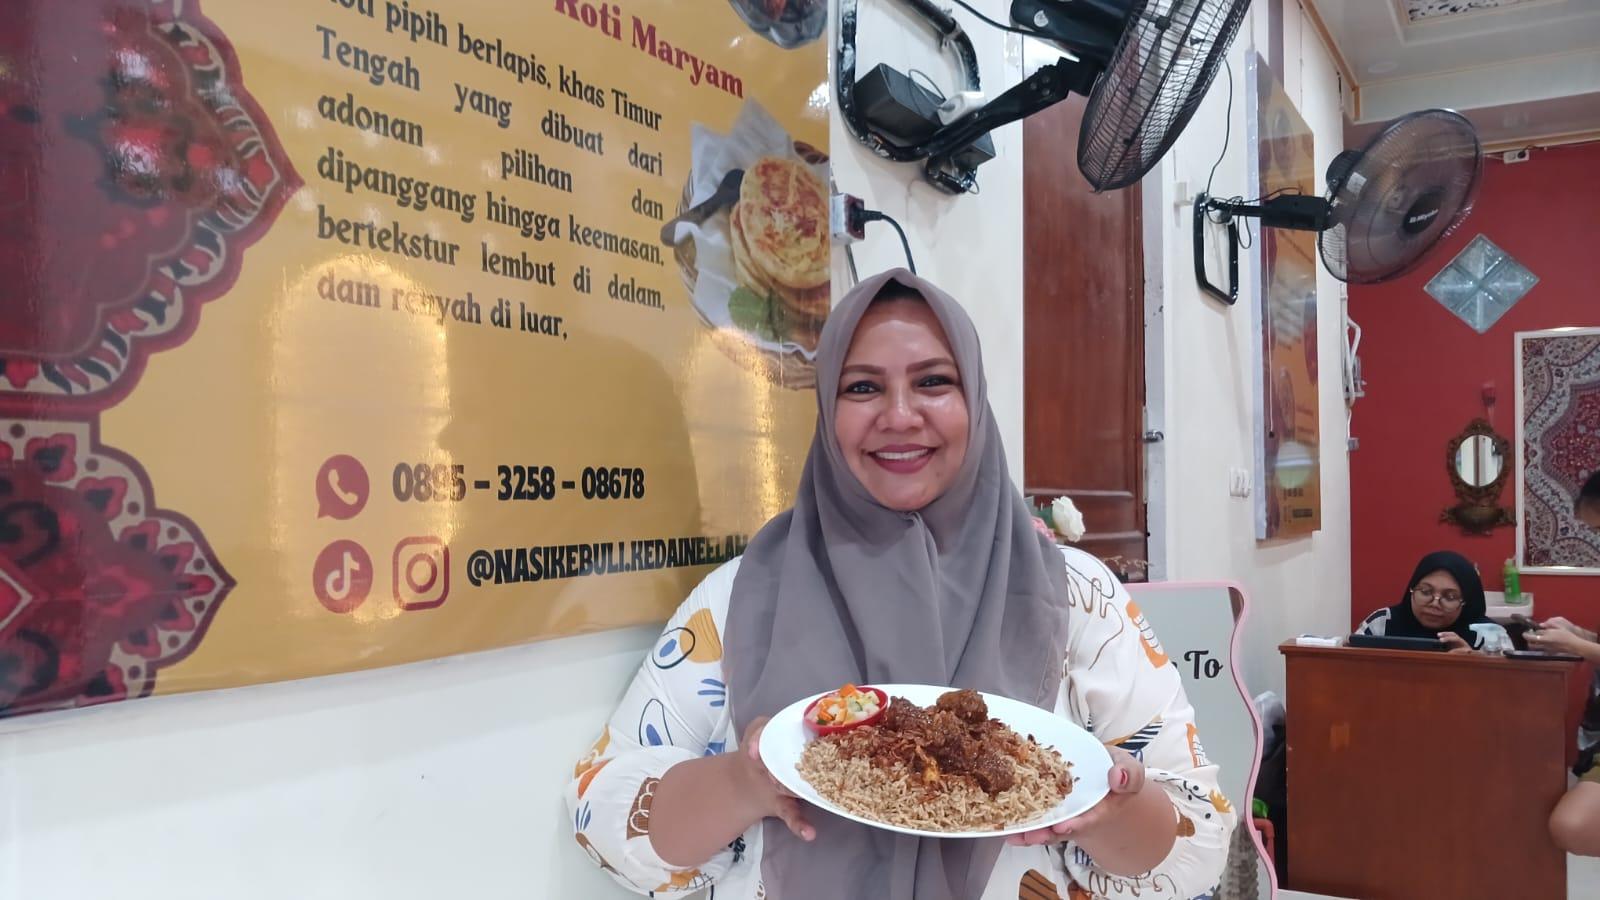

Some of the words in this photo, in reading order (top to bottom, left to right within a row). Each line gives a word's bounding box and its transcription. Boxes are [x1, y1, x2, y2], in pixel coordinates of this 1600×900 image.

[316, 25, 421, 91] Tengah
[454, 83, 513, 128] yang
[541, 109, 604, 156] dibuat
[628, 142, 663, 177] dari
[330, 0, 375, 18] ti
[385, 1, 448, 47] pipih
[558, 64, 606, 109] khas
[611, 87, 662, 131] Timur
[632, 15, 744, 99] Maryam
[317, 92, 423, 148] adonan
[500, 149, 573, 194] pilihan
[631, 188, 663, 221] dan
[317, 147, 477, 223] dipanggang
[486, 191, 561, 242] hingga
[317, 204, 461, 266] bertekstur
[481, 241, 557, 288] lembut
[573, 265, 592, 295] di
[316, 267, 381, 308] dam
[490, 297, 512, 329] di
[519, 301, 568, 341] luar,
[392, 462, 466, 502] 0895
[497, 465, 556, 501] 3258
[581, 467, 645, 500] 08678
[1183, 649, 1224, 680] To
